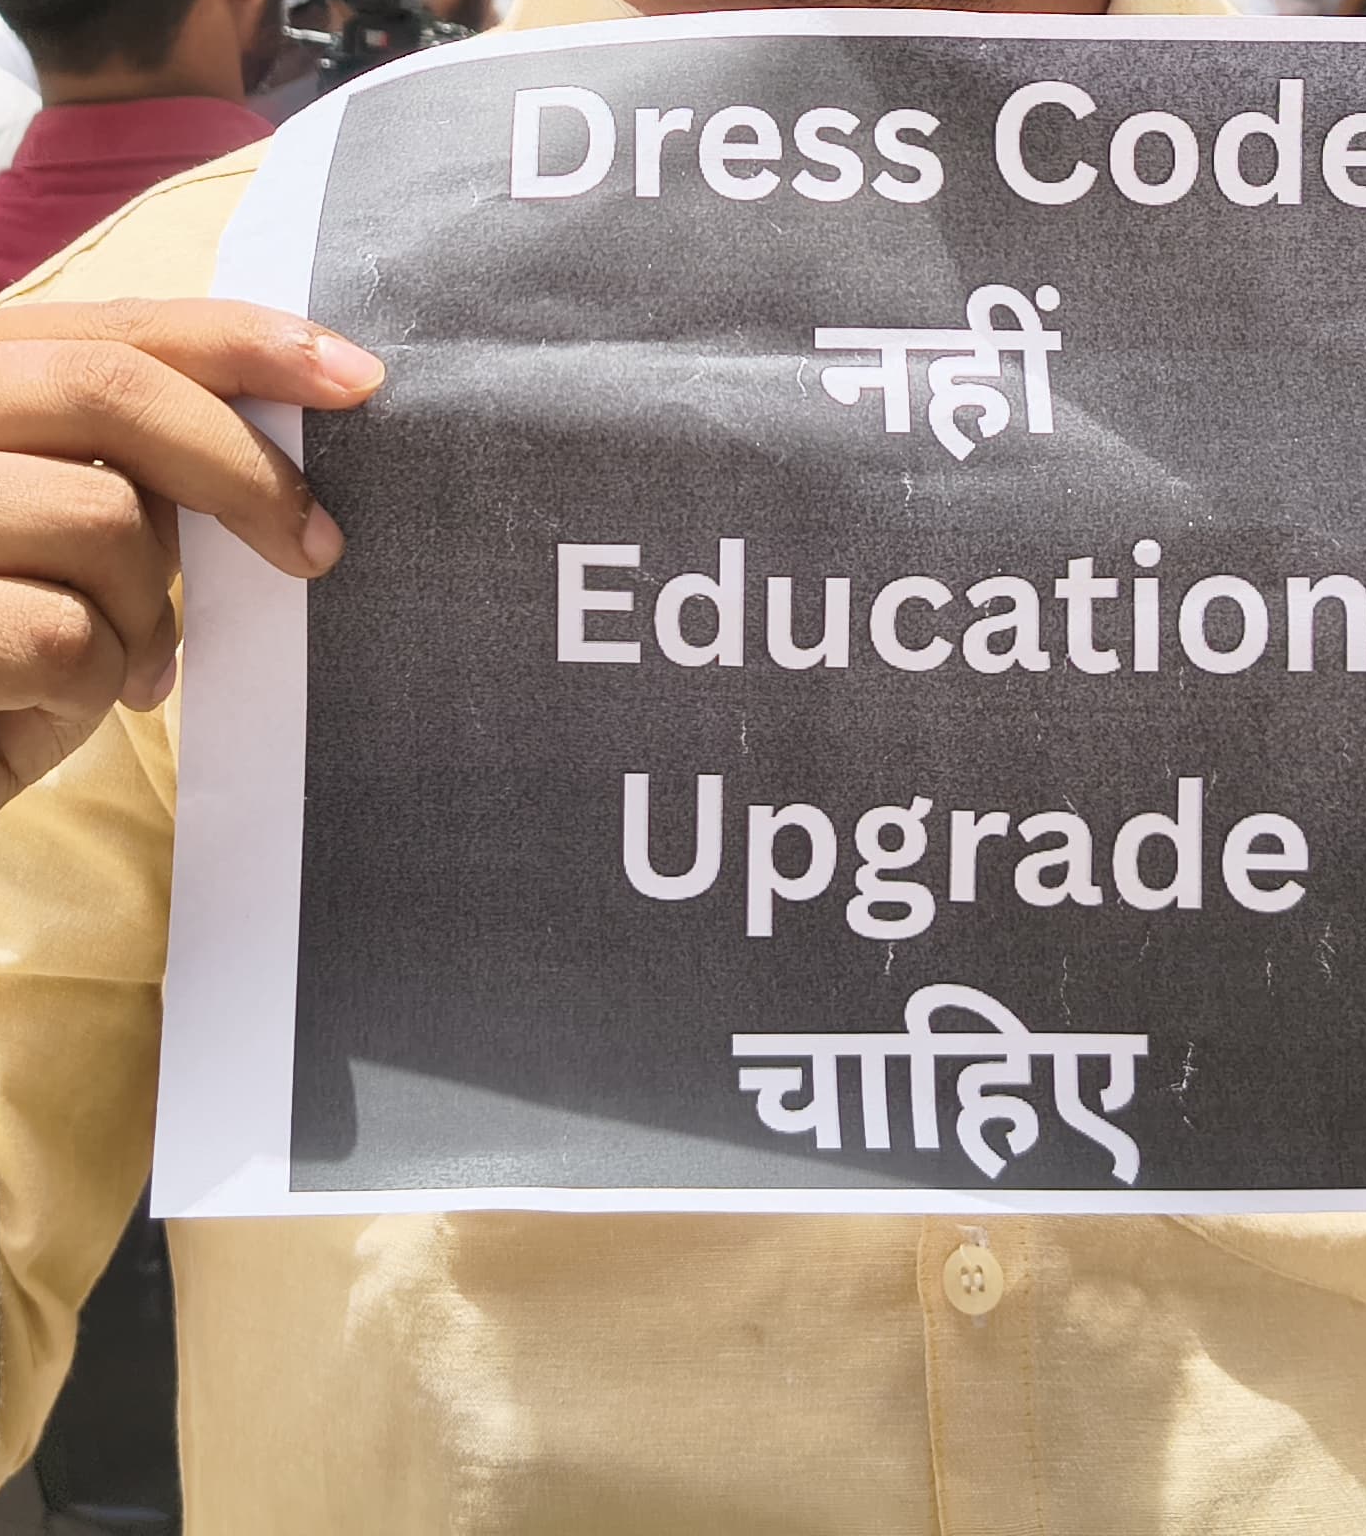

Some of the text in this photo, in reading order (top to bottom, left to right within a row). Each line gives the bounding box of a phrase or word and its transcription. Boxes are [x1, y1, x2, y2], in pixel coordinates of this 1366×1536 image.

[508, 83, 945, 205] Dress
[813, 283, 1063, 462] नहीं
[623, 772, 1309, 940] Upgrade
[731, 983, 1149, 1185] चाहिए
